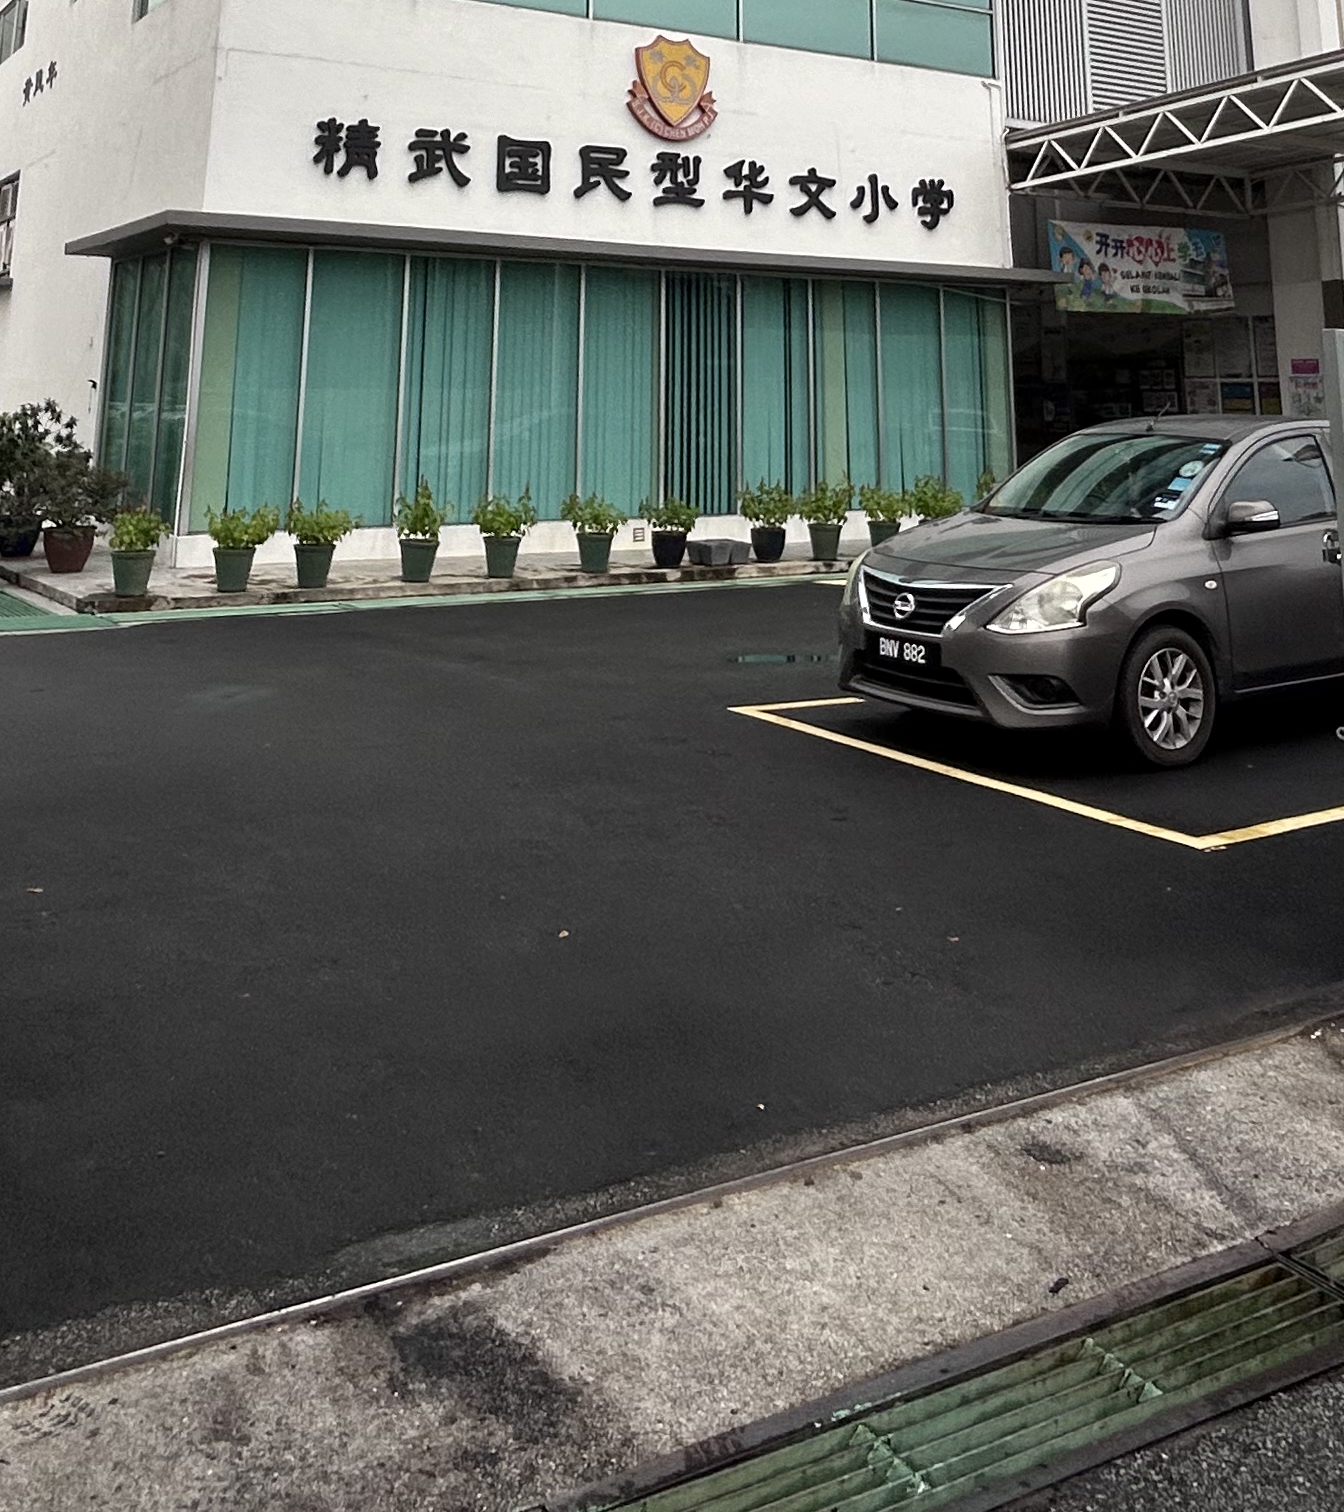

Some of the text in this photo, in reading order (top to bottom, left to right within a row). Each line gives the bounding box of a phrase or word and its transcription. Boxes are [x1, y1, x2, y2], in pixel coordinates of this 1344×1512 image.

[313, 118, 955, 230] 精武国民型华文小学
[879, 637, 926, 664] BNV 882
